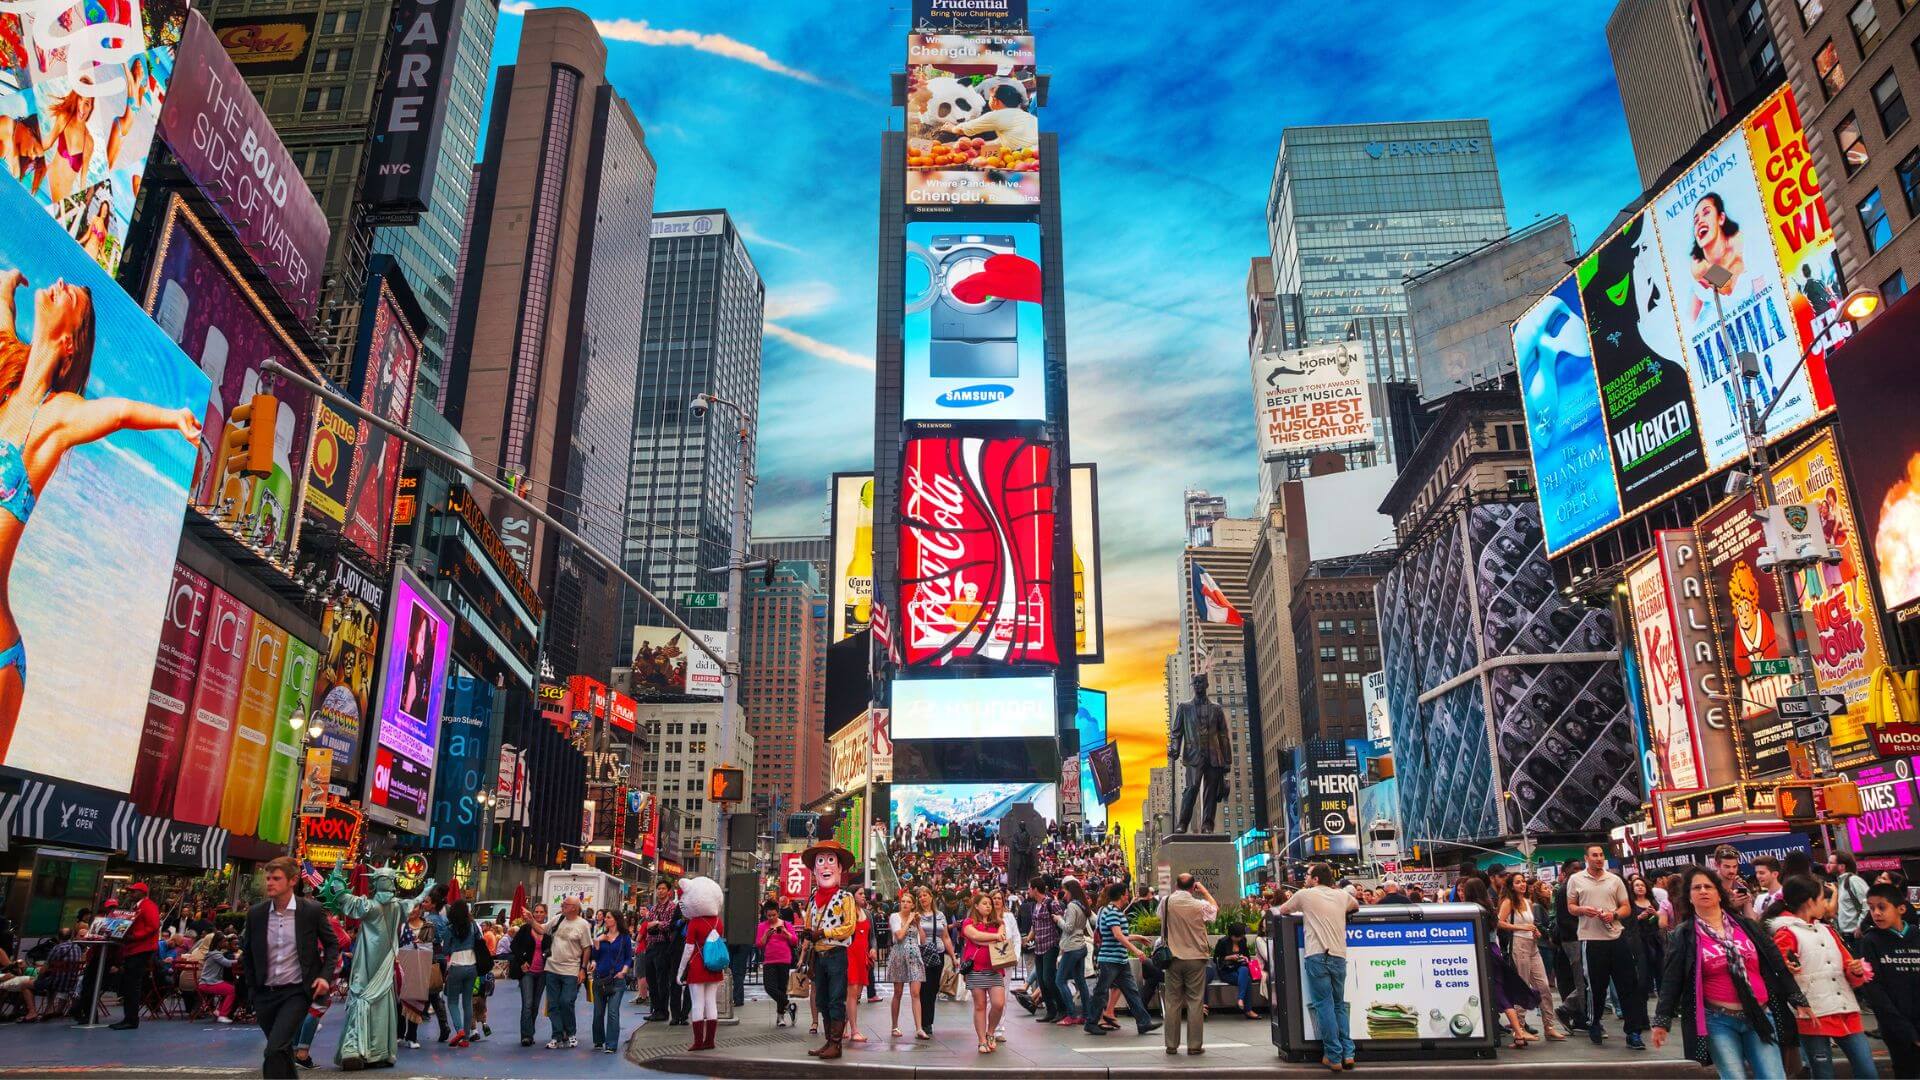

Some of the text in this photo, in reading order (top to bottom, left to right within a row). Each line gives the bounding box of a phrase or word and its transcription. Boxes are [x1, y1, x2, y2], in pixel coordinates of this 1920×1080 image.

[931, 0, 1008, 9] Prudential
[931, 10, 950, 18] Bring
[970, 10, 1009, 18] Challenges
[910, 44, 1035, 58] Chengdu, China.
[388, 0, 438, 132] ARE
[207, 66, 288, 208] THE BOLD
[1389, 138, 1480, 156] BARCLAYS
[379, 163, 411, 175] NYC
[1675, 151, 1720, 195] THE FUN
[1665, 152, 1738, 221] NEVER STOPS!
[193, 112, 310, 294] SIDE OF WATER
[910, 189, 985, 204] Chengdu,
[1693, 296, 1787, 389] MAMMA
[1300, 349, 1357, 371] MORMON
[946, 390, 1005, 401] SAMSUNG
[1266, 387, 1297, 396] WINNER
[1306, 382, 1328, 390] TONY
[1328, 379, 1361, 389] AWARDS
[1607, 377, 1638, 404] BIGGEST
[1267, 387, 1362, 407] BEST MUSICAL
[1311, 398, 1363, 417] BEST
[1269, 412, 1364, 434] MUSICAL OF
[1270, 433, 1300, 444] THIS
[312, 425, 339, 488] Q
[1807, 453, 1824, 477] Jessie
[1543, 444, 1605, 495] PHANTOM
[1806, 466, 1835, 493] MUELLER
[1556, 489, 1600, 523] OPERA
[174, 564, 208, 590] SPARKLING
[849, 577, 871, 589] Coro
[343, 568, 361, 596] JOY
[360, 578, 384, 612] RIDE!
[164, 577, 206, 637] ICE
[686, 594, 692, 605] W
[695, 594, 705, 606] 46
[1812, 590, 1852, 633] NICE
[210, 605, 247, 660] ICE
[704, 634, 713, 643] By
[1676, 545, 1727, 730] PALACE
[252, 628, 281, 678] ICE
[285, 649, 313, 696] ICE
[696, 661, 708, 670] did
[1753, 662, 1762, 674] W
[1765, 662, 1776, 673] 46
[1820, 657, 1865, 682] If You Can Get It
[1741, 675, 1793, 719] Annie
[1784, 703, 1803, 712] ONE
[461, 716, 483, 728] Stanley
[1799, 722, 1824, 735] ONE WAY
[375, 764, 391, 793] CNN
[1318, 774, 1359, 794] HERO
[1321, 800, 1347, 811] JUNE 6
[1859, 784, 1896, 812] IMES
[78, 806, 99, 819] WE'RE
[75, 818, 93, 830] OPEN
[1326, 820, 1342, 828] TNT
[1857, 807, 1914, 838] SQUARE
[183, 832, 201, 844] WE'RE
[180, 843, 197, 856] OPEN
[1644, 859, 1656, 870] BOX
[1656, 856, 1675, 869] OFFICE
[1366, 929, 1401, 938] Green
[1405, 928, 1427, 938] and
[1430, 927, 1467, 937] Clean!
[1370, 957, 1406, 968] recycle
[1431, 956, 1468, 966] recycle
[1383, 969, 1395, 977] all
[1433, 968, 1468, 977] bottles
[1376, 982, 1404, 991] paper
[1435, 980, 1469, 988] & cans
